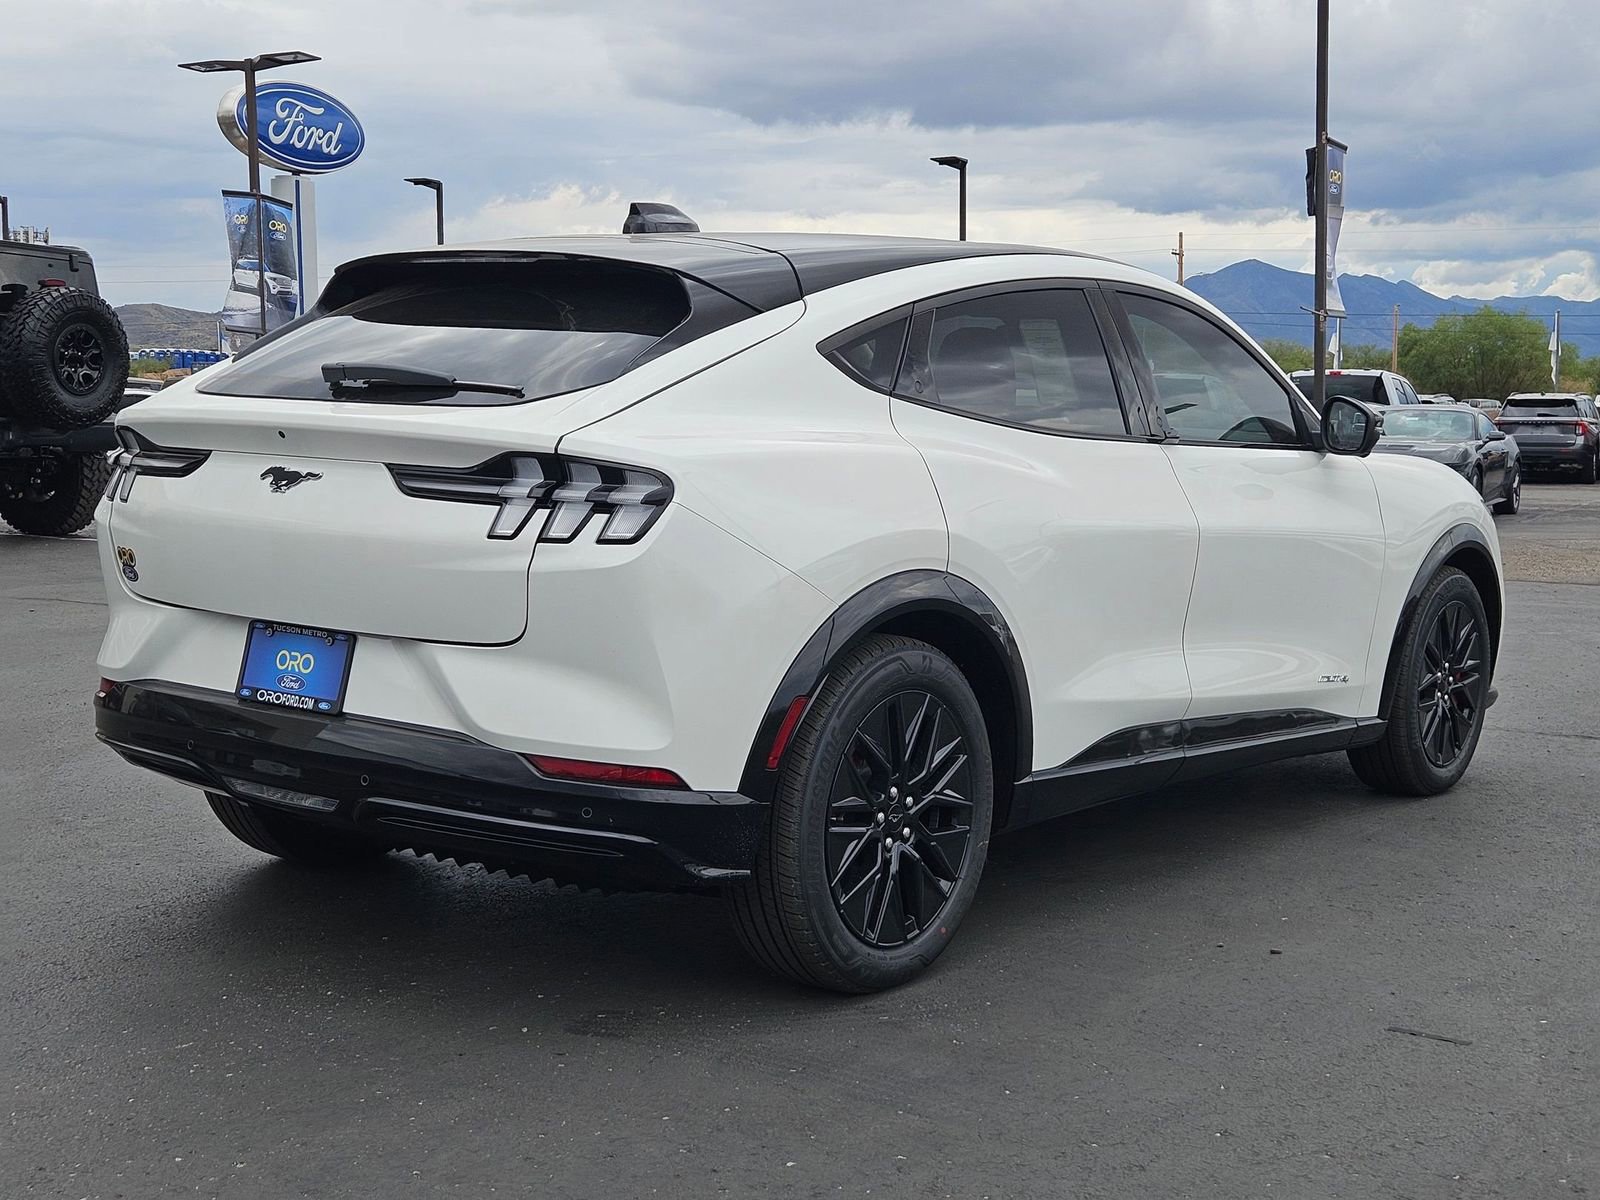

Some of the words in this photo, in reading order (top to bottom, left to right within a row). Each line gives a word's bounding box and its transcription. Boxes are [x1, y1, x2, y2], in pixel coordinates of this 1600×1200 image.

[268, 97, 344, 155] Ford
[269, 220, 287, 233] ORO
[273, 623, 302, 635] TUCSON
[302, 628, 328, 639] METRO
[276, 649, 315, 674] ORO
[280, 674, 302, 690] Ford
[256, 689, 315, 710] OROFORD.COM
